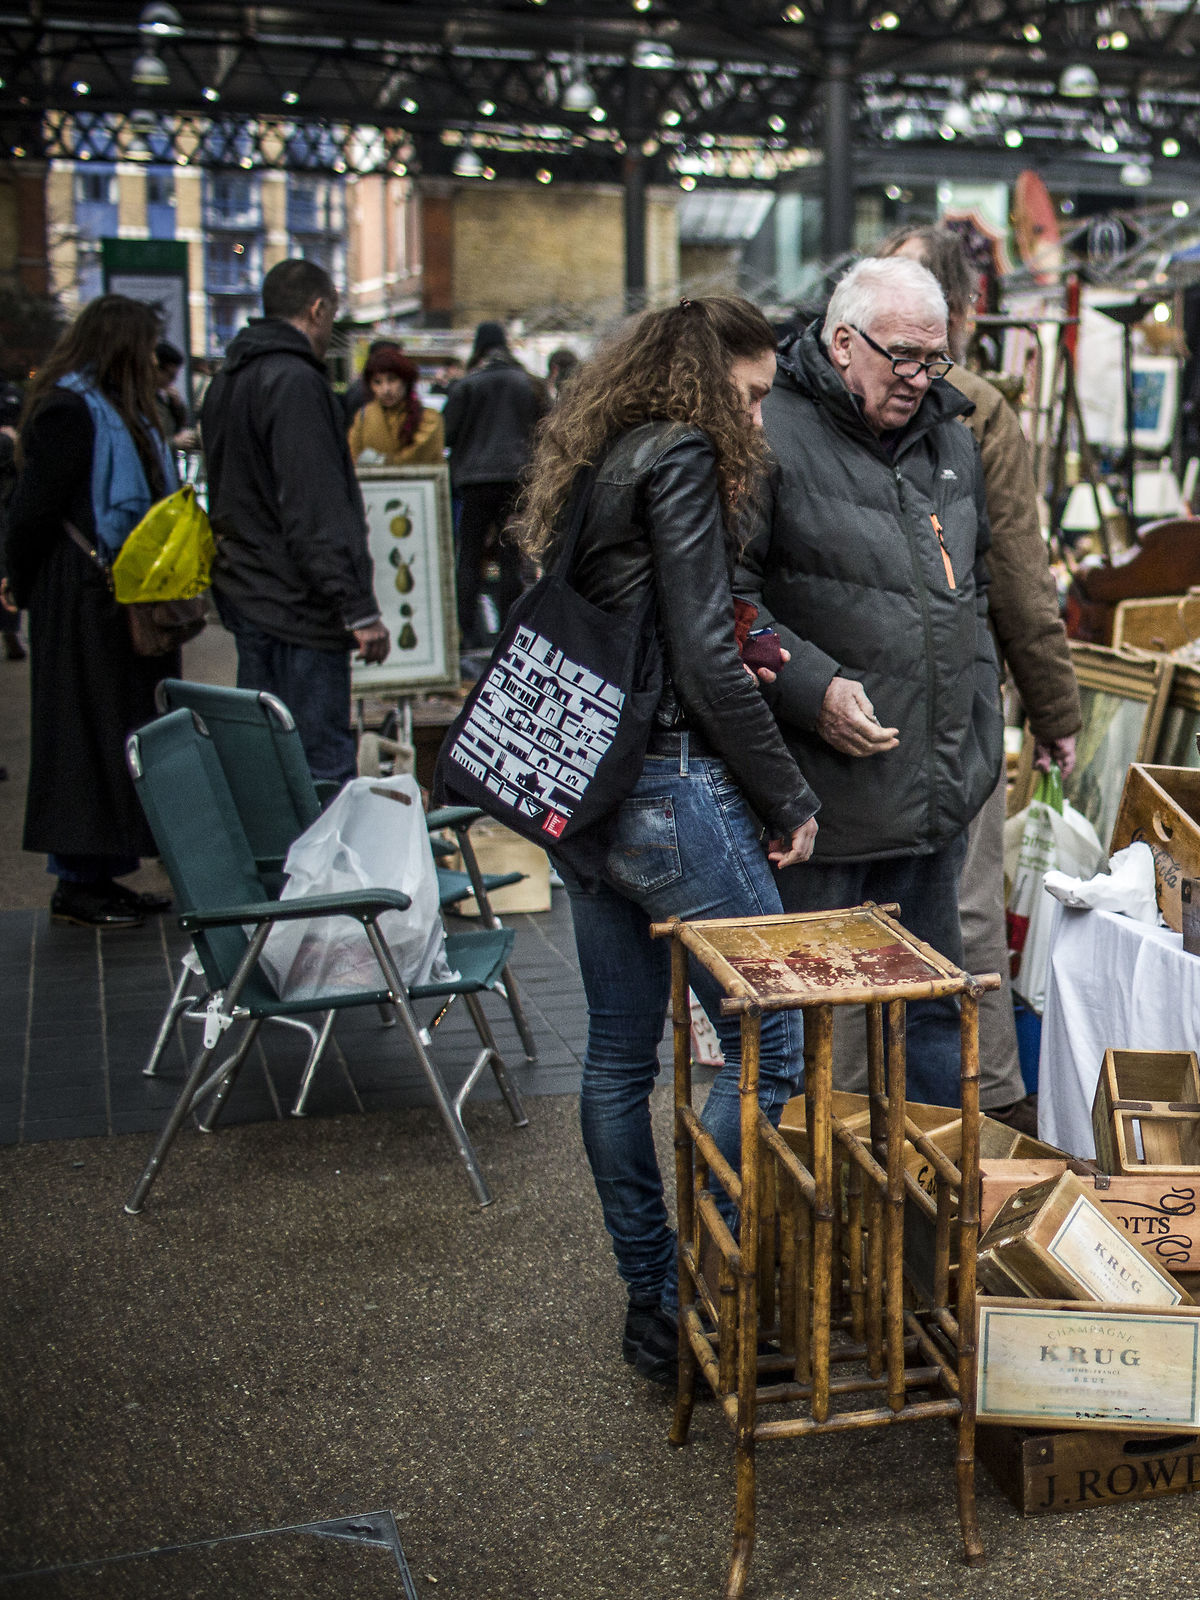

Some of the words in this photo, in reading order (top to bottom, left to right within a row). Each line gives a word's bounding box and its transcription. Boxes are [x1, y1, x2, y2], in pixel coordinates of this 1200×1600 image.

[1093, 1242, 1143, 1294] KRUG
[1047, 1325, 1134, 1343] CHAMPAGNE
[1039, 1344, 1141, 1366] KRUG
